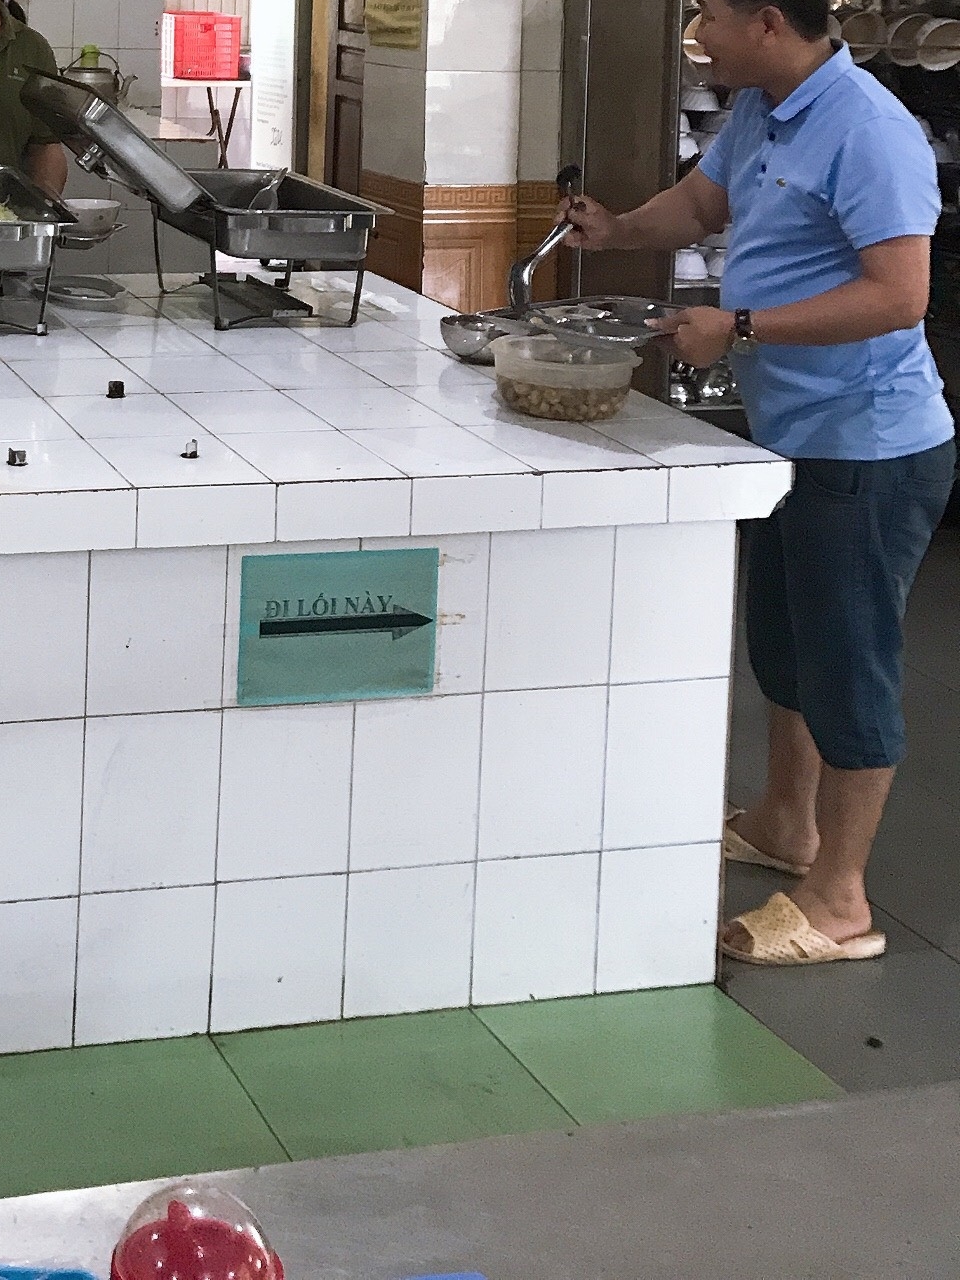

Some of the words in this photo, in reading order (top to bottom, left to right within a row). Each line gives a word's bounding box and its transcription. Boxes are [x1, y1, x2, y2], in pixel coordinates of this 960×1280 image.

[265, 599, 291, 618] ĐI
[297, 592, 340, 617] LỐI
[344, 590, 393, 615] NÀY
